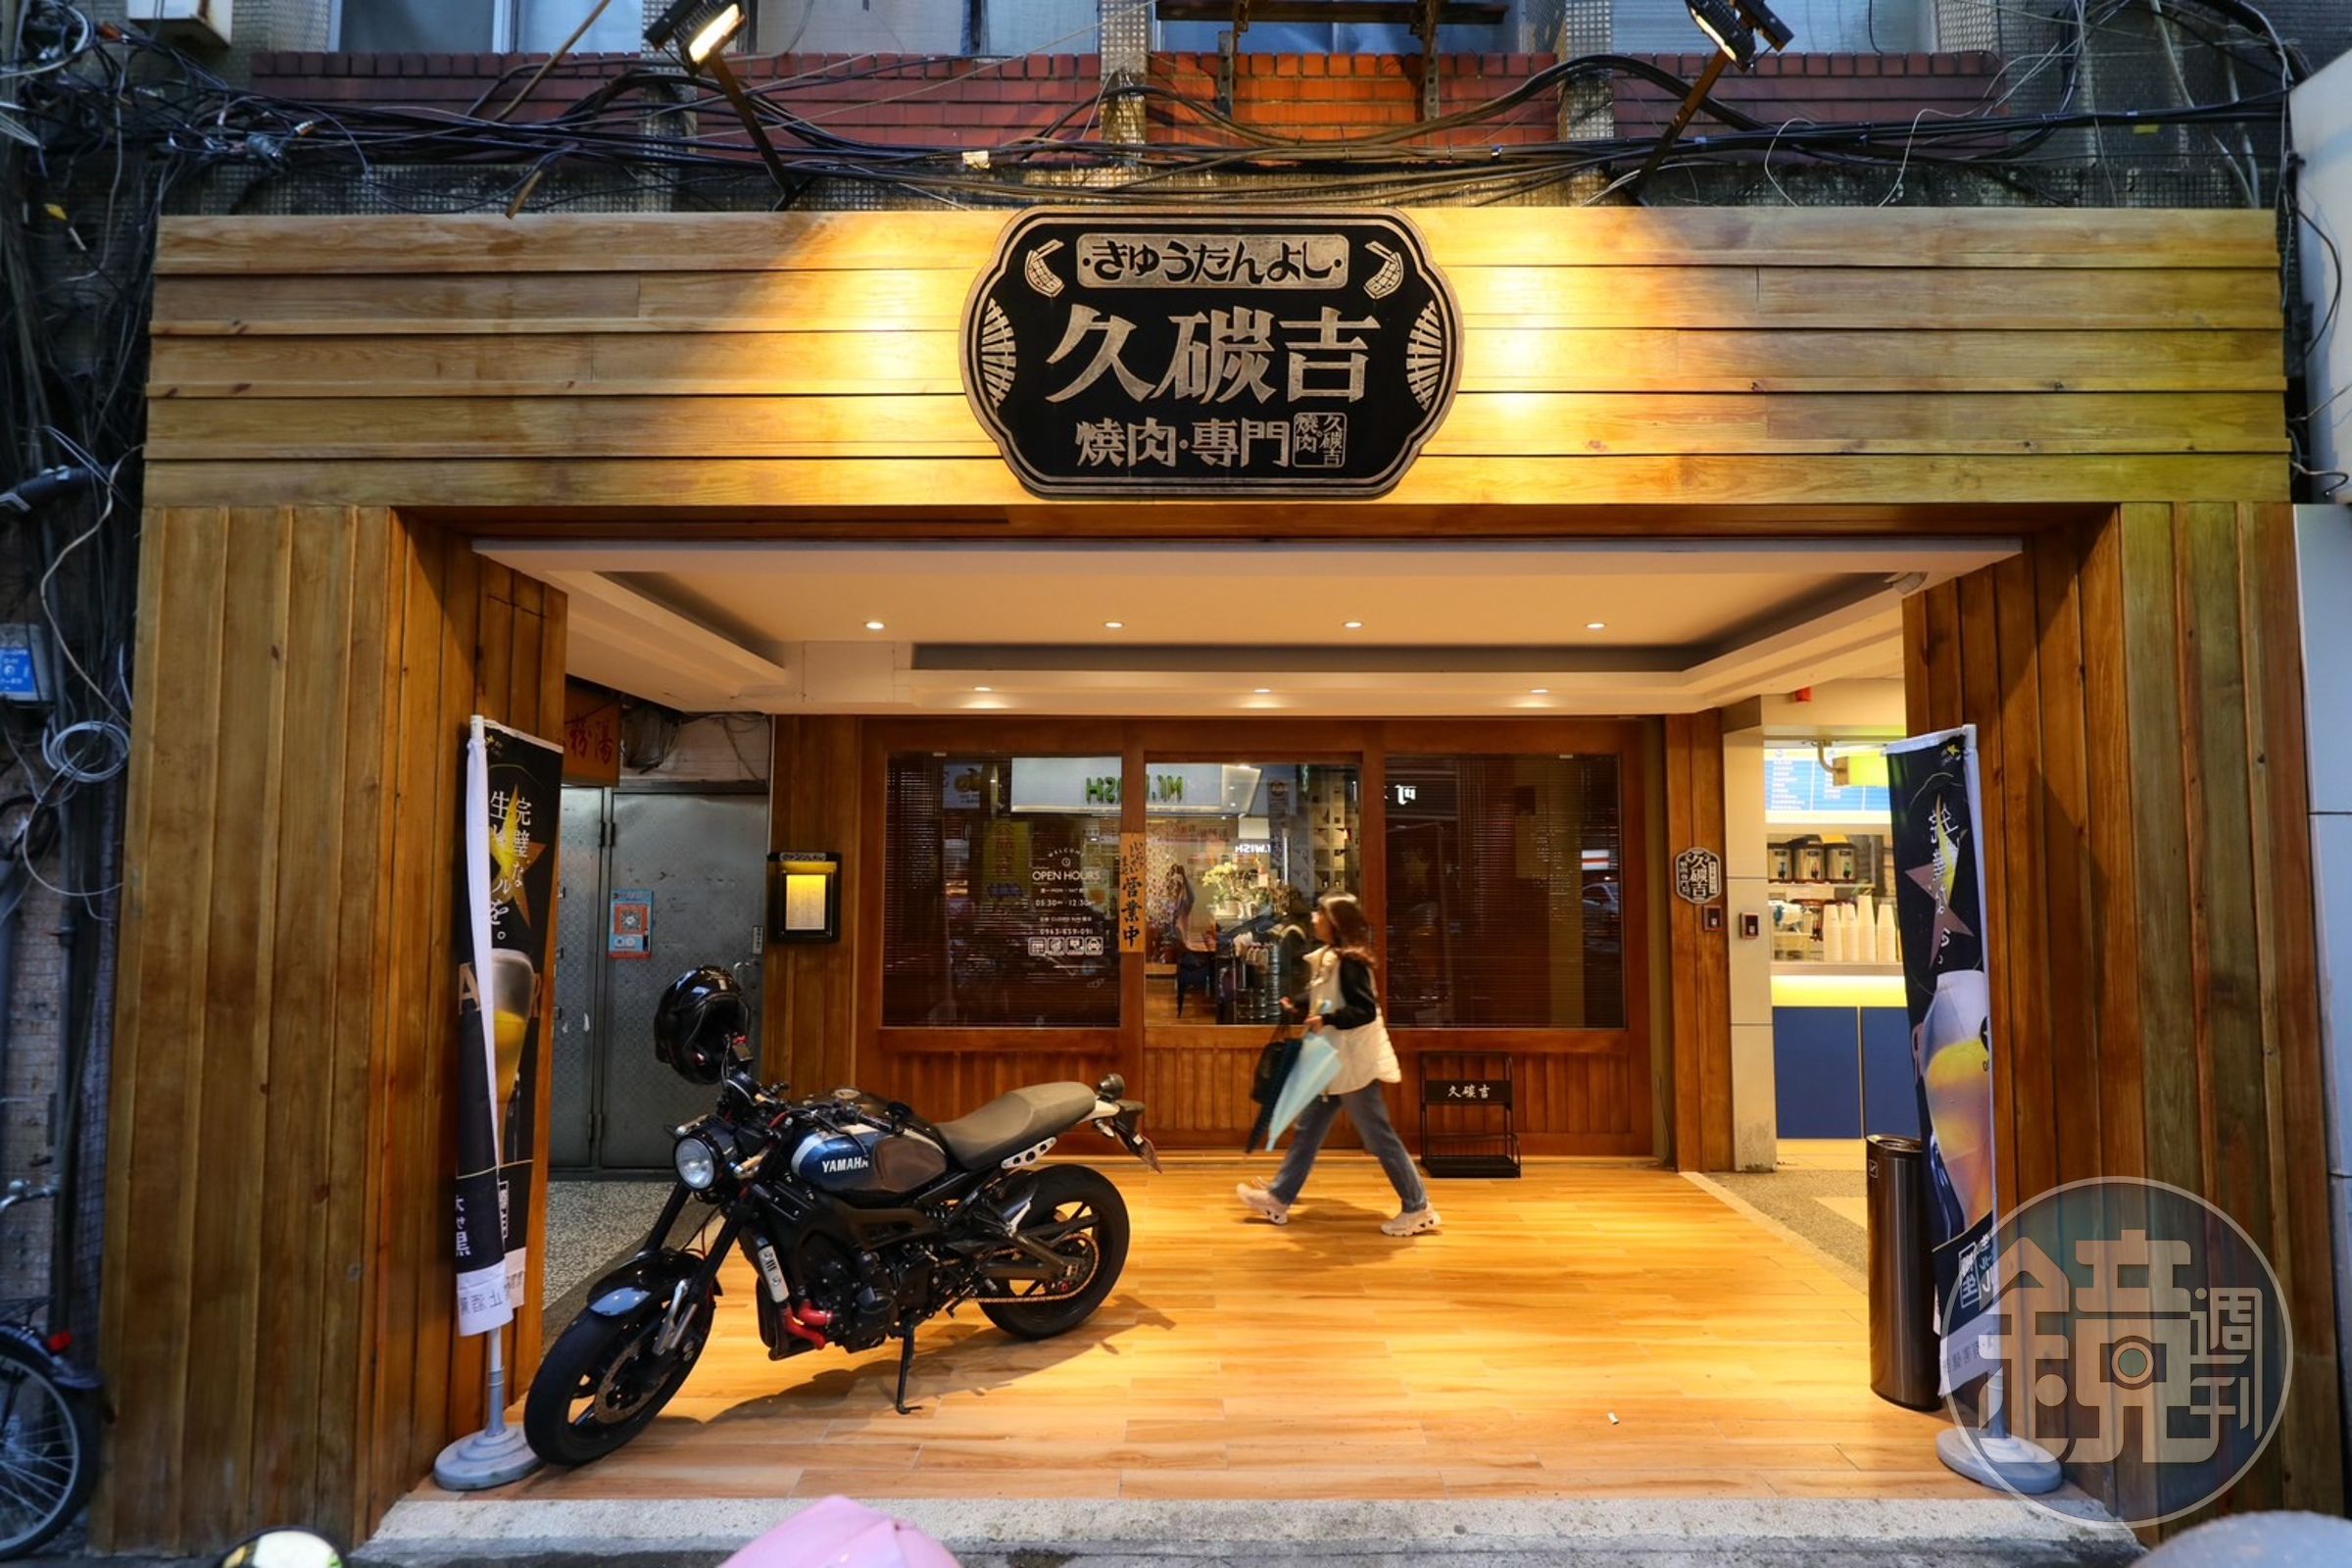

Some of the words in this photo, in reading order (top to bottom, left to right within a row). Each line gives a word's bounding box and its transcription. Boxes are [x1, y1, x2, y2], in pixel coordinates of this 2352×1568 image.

[1046, 303, 1381, 405] 久碳吉
[1032, 870, 1061, 881] OPEN
[1063, 870, 1101, 881] HOURS
[821, 1156, 869, 1173] YAMAHA
